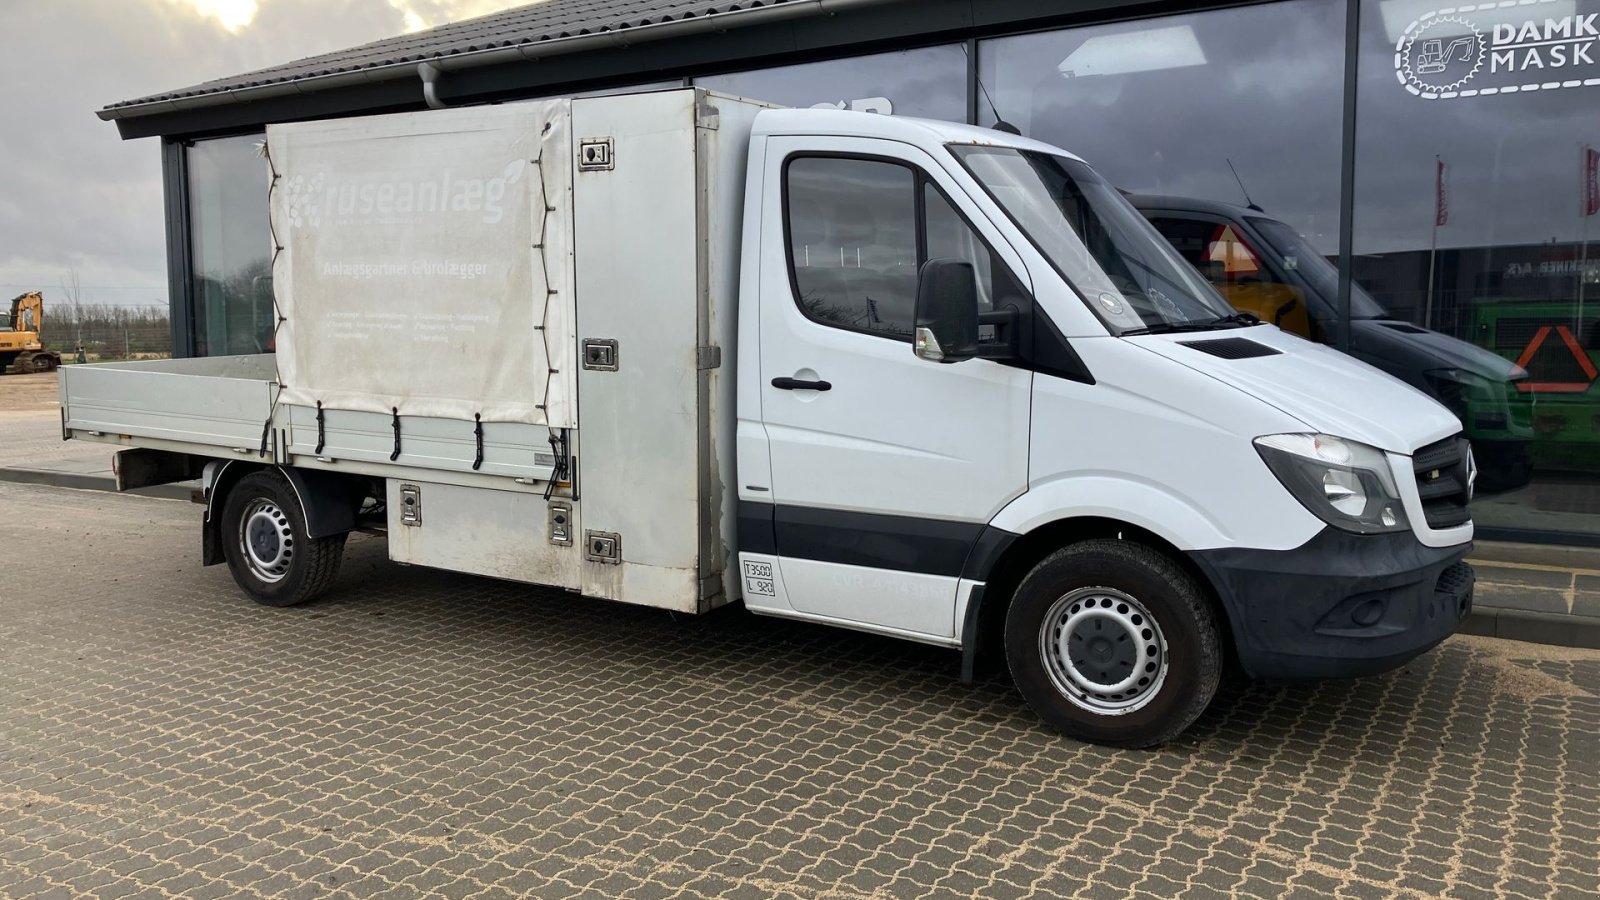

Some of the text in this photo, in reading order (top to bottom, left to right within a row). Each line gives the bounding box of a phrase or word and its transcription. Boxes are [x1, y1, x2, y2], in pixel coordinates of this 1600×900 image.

[1492, 13, 1600, 45] DAMK
[1491, 42, 1594, 73] MASK
[757, 581, 773, 593] 920
